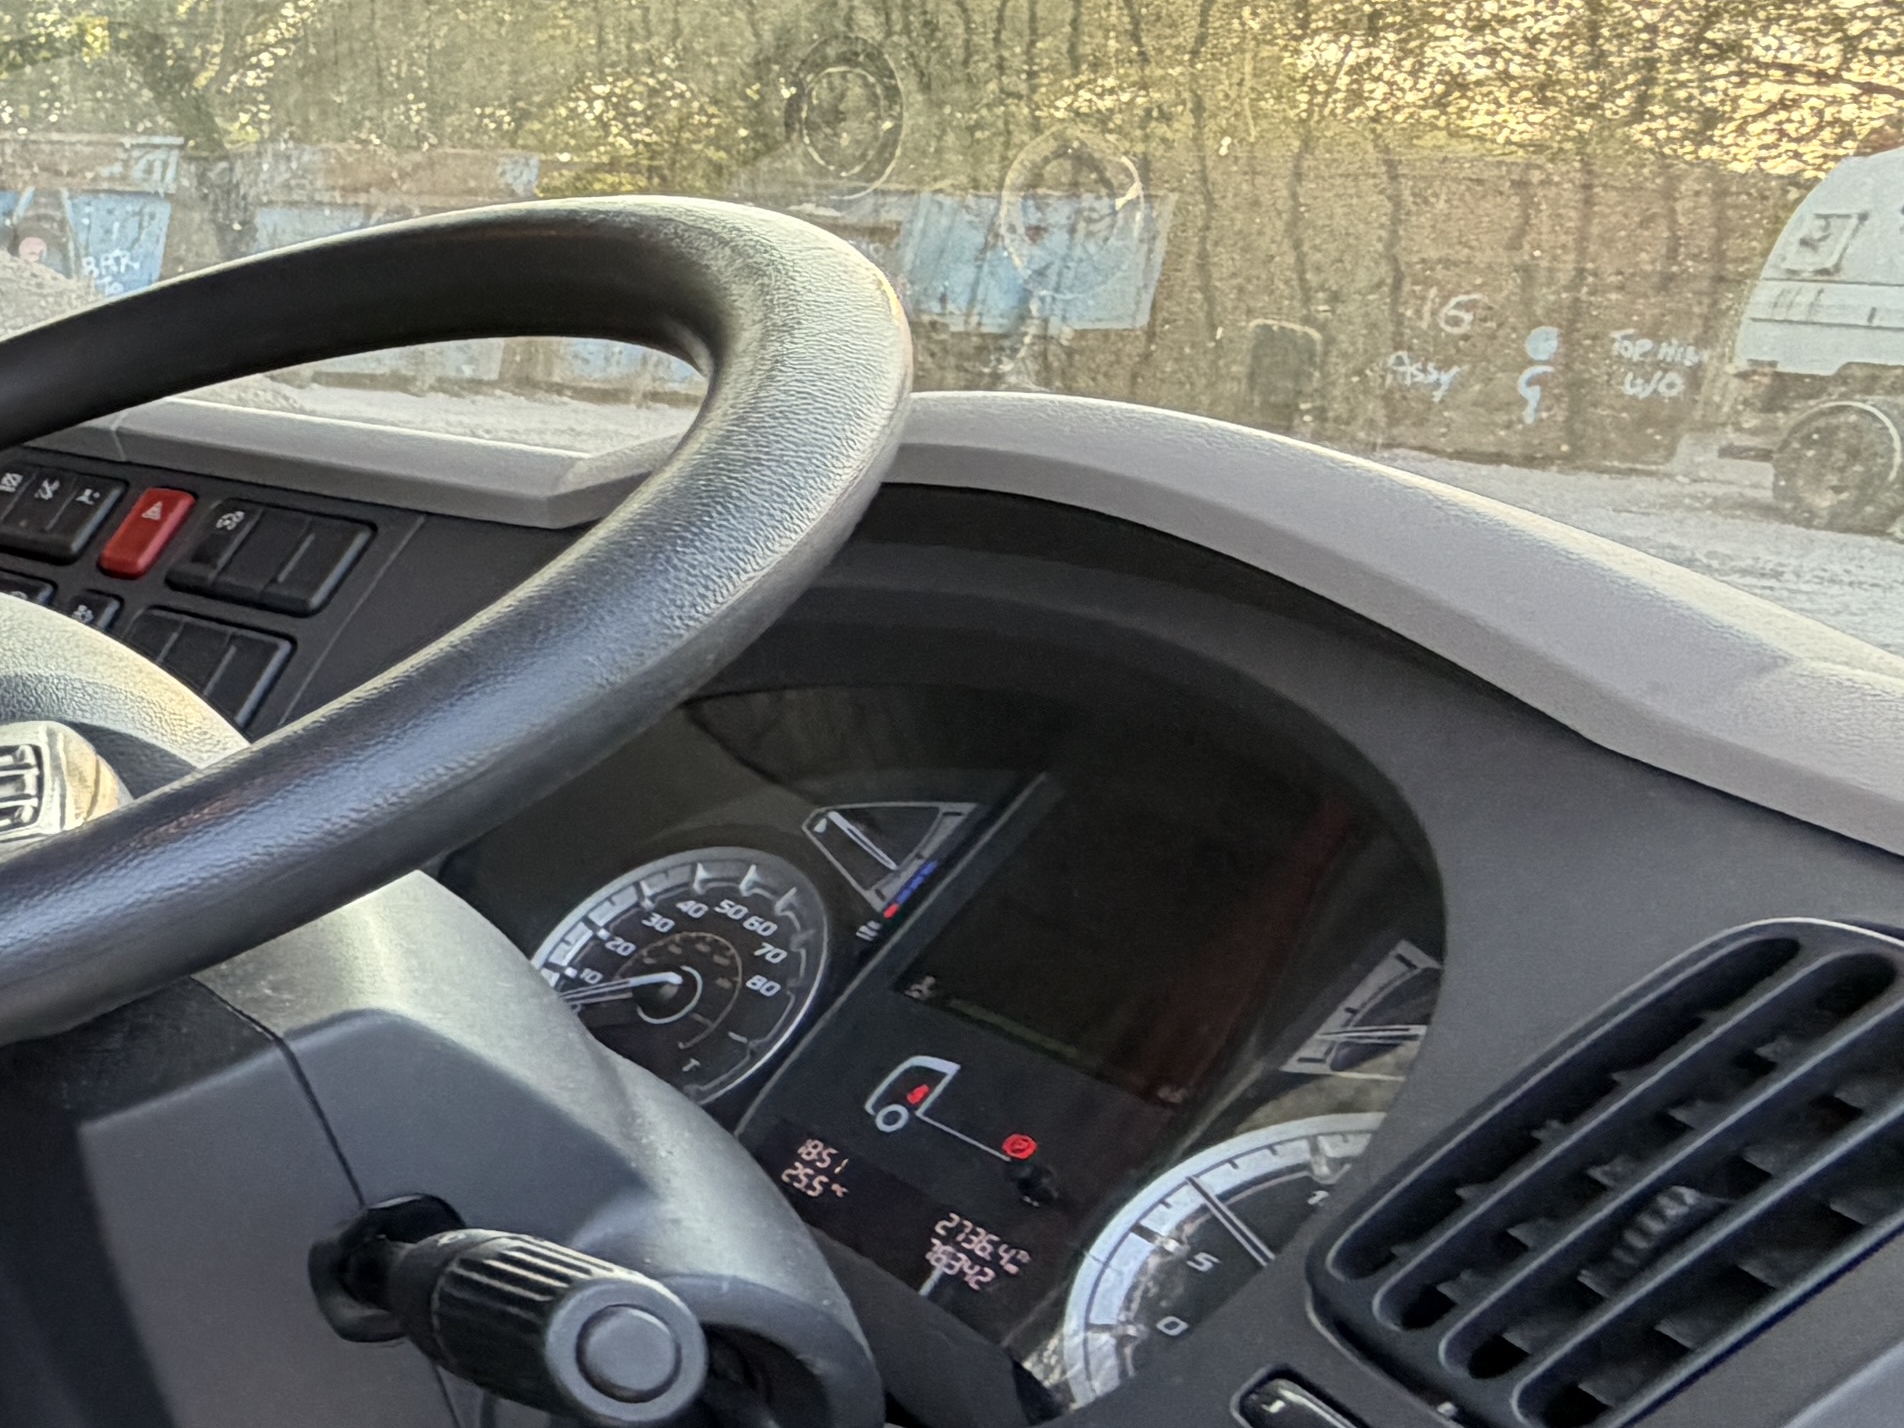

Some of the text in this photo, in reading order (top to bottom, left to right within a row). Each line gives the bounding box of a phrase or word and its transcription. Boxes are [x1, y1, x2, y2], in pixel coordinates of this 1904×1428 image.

[676, 900, 708, 919] 40
[714, 899, 749, 920] 50
[642, 913, 675, 933] 30
[742, 916, 778, 937] 60
[605, 937, 636, 956] 20
[754, 942, 787, 964] 70
[580, 968, 604, 984] 10
[746, 975, 781, 997] 80
